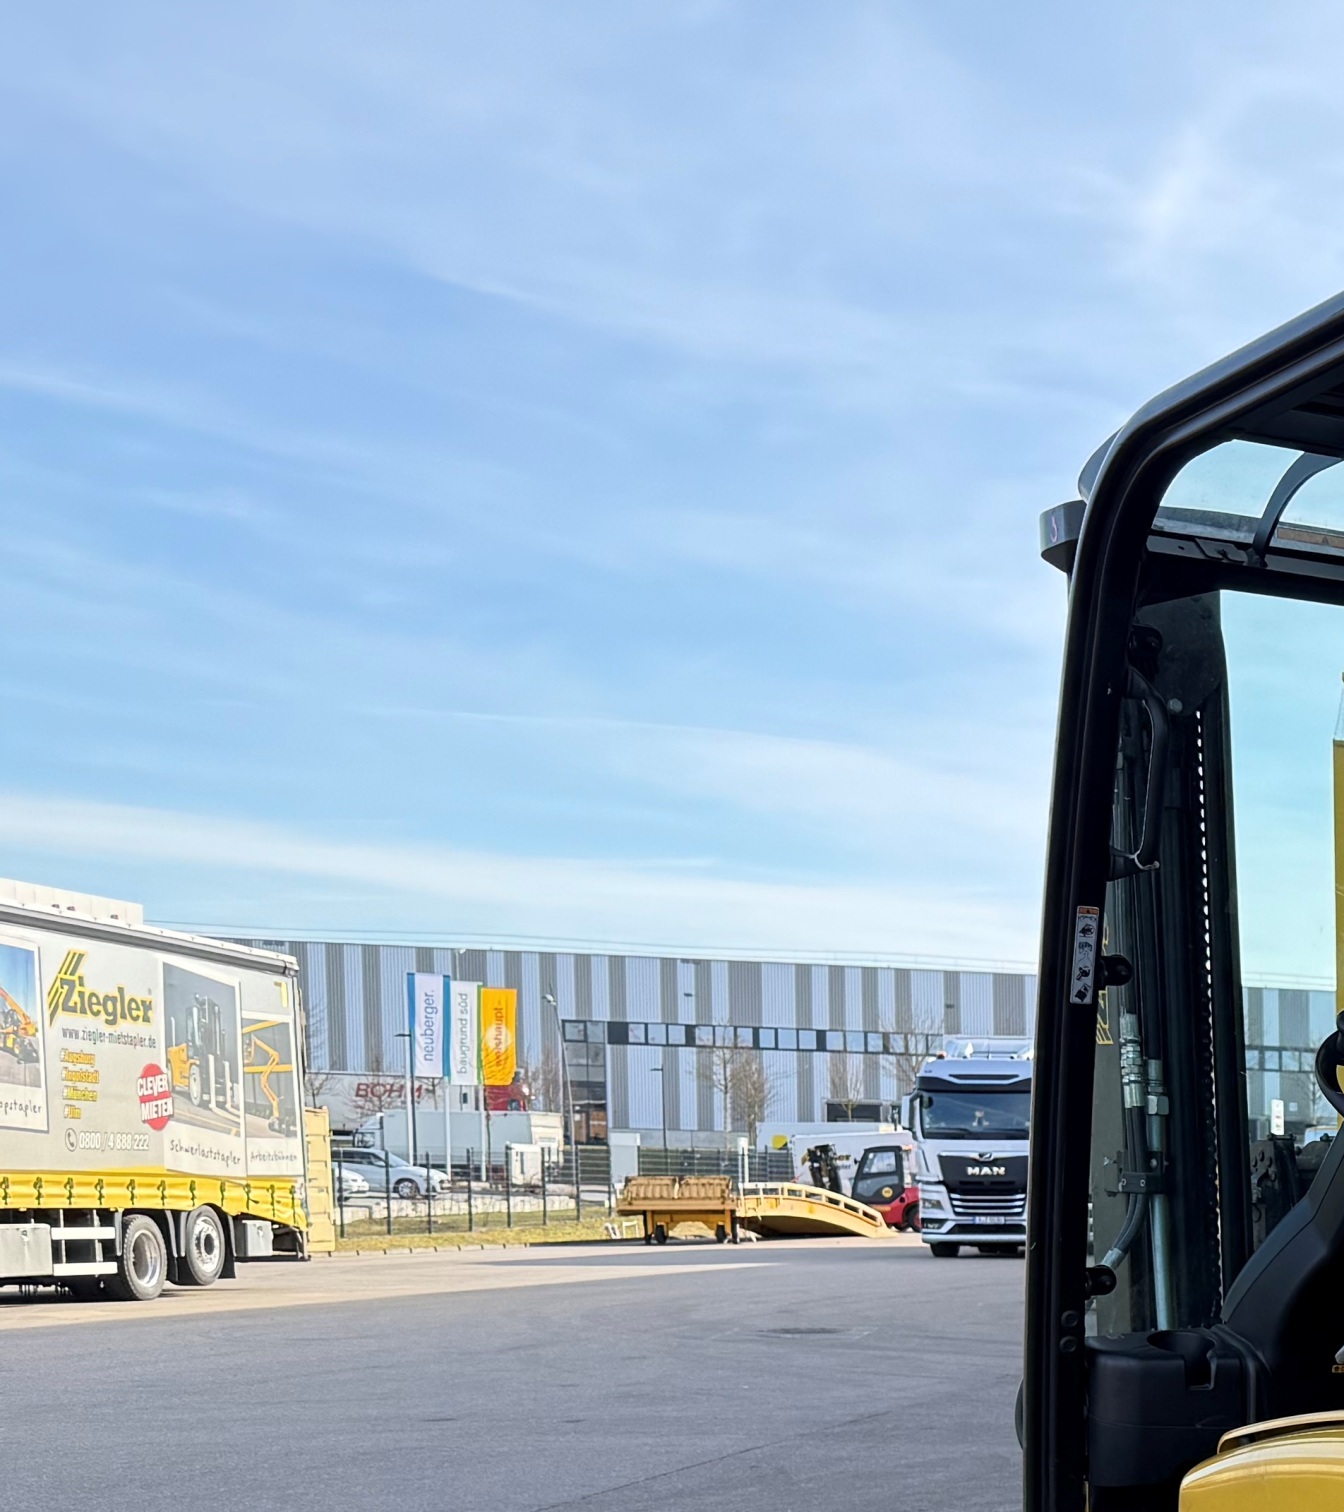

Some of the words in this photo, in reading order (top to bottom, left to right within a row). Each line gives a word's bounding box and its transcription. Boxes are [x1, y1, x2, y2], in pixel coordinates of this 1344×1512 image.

[58, 974, 154, 1028] Ziegler
[457, 993, 469, 1015] süd
[61, 1026, 157, 1050] www.ziegler-mietstapler.de
[420, 989, 438, 1062] neuberger.
[456, 1018, 470, 1074] baugrund
[136, 1072, 170, 1097] CLEVER
[141, 1097, 174, 1122] MIETEN
[79, 1131, 101, 1150] 0800
[133, 1134, 149, 1151] 222
[170, 1139, 241, 1167] Schwerlaststapler
[966, 1166, 1006, 1176] MAN
